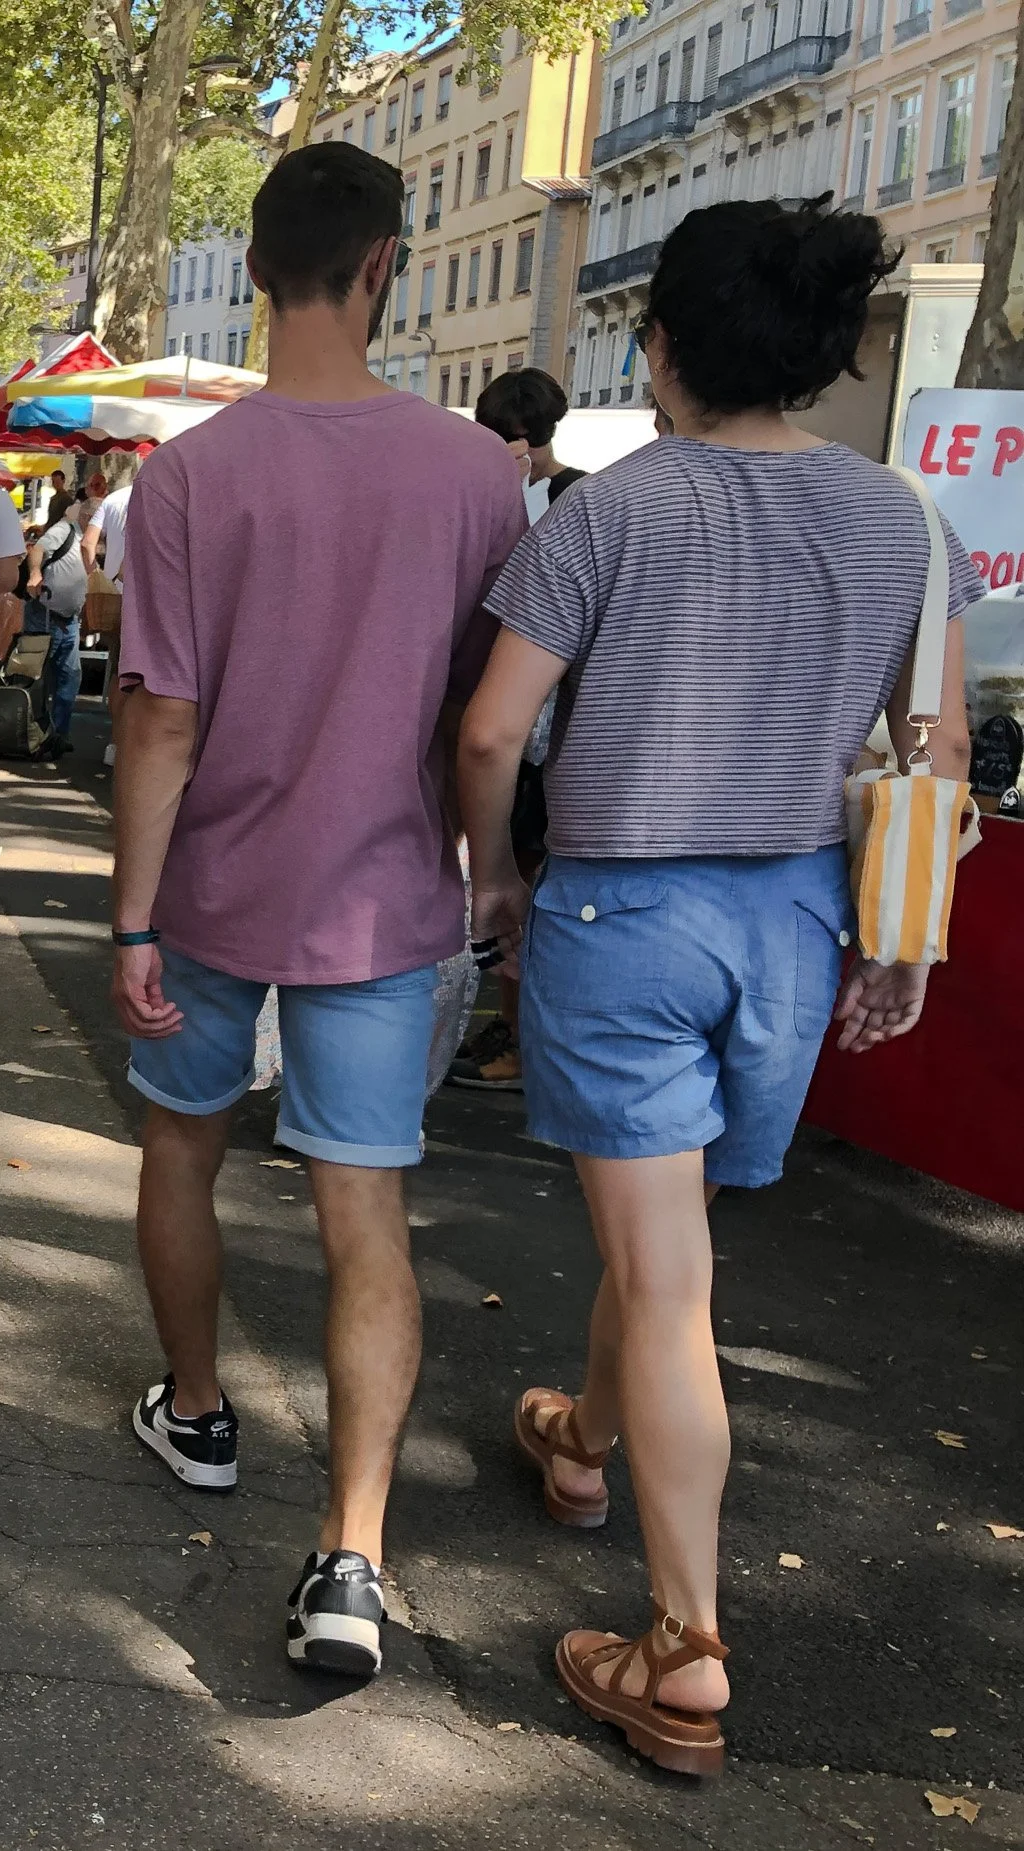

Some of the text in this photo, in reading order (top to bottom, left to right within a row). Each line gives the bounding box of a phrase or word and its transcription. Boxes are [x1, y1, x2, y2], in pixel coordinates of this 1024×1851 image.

[919, 424, 981, 476] LE
[970, 550, 1024, 590] PO
[334, 1573, 360, 1584] AIR
